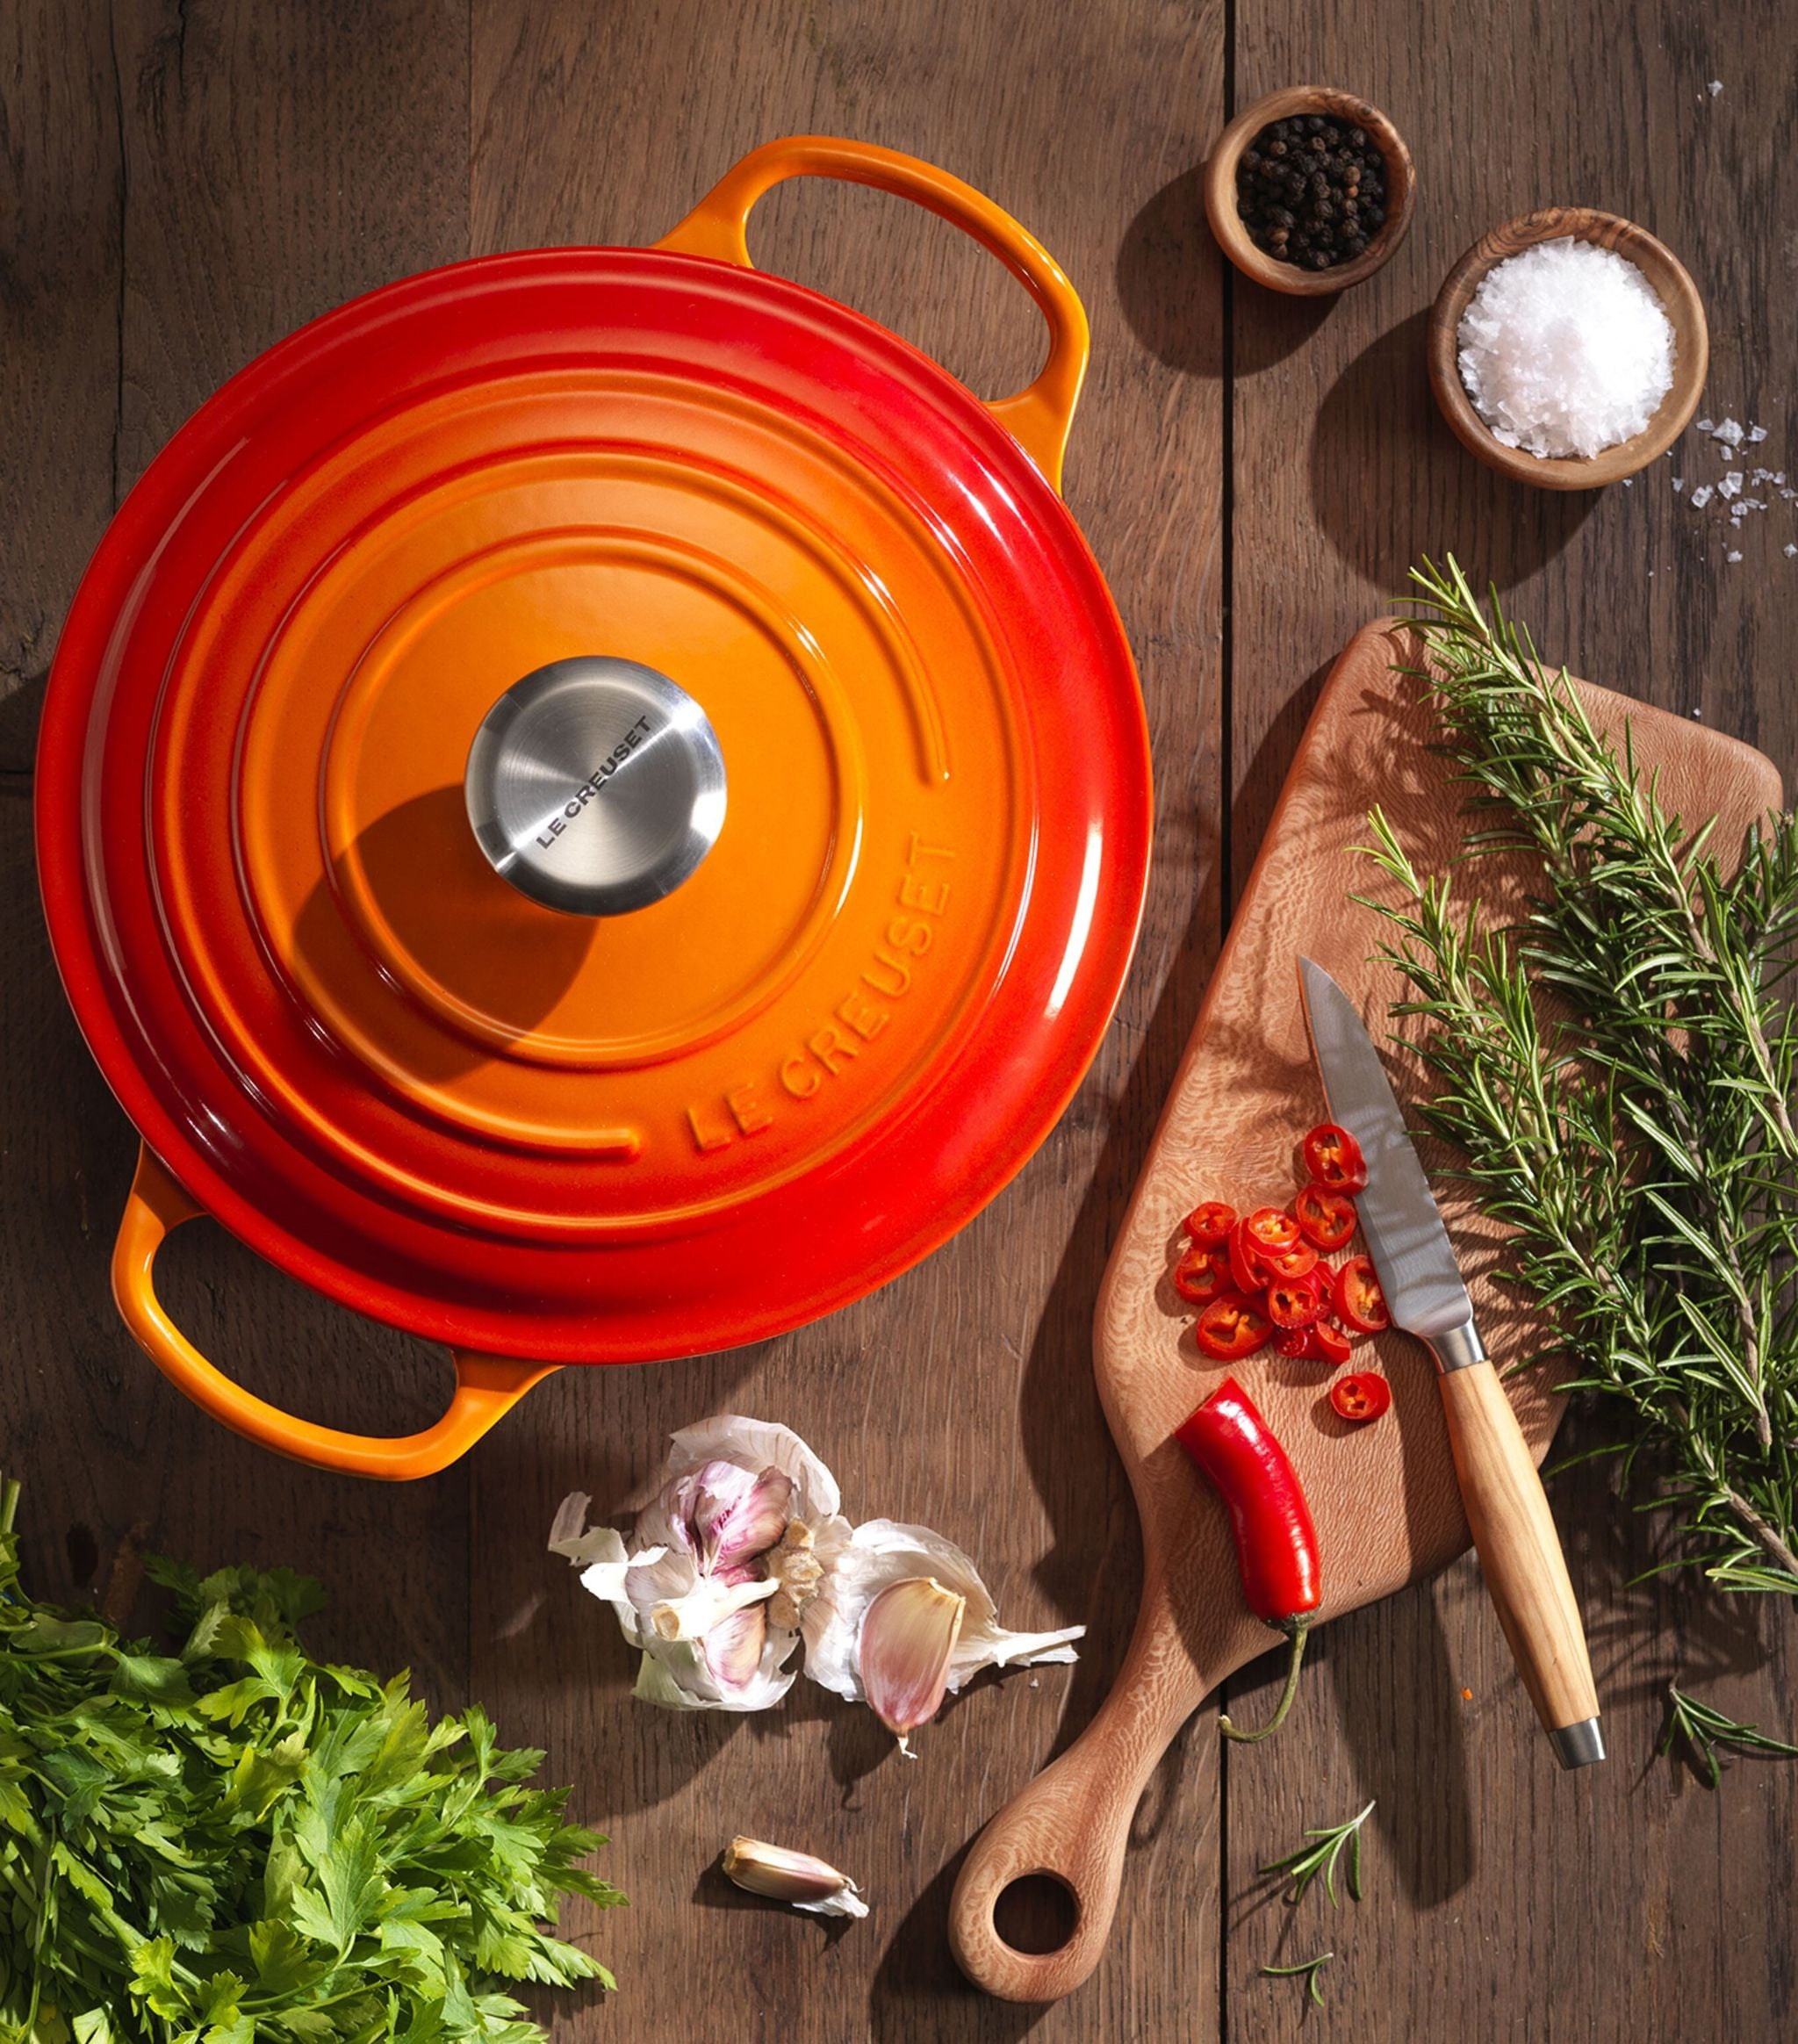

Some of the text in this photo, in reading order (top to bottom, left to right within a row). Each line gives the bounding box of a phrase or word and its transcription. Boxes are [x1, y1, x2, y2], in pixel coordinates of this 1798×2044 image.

[536, 715, 651, 850] LE CREUSET
[686, 830, 955, 1154] LE CREUSET
